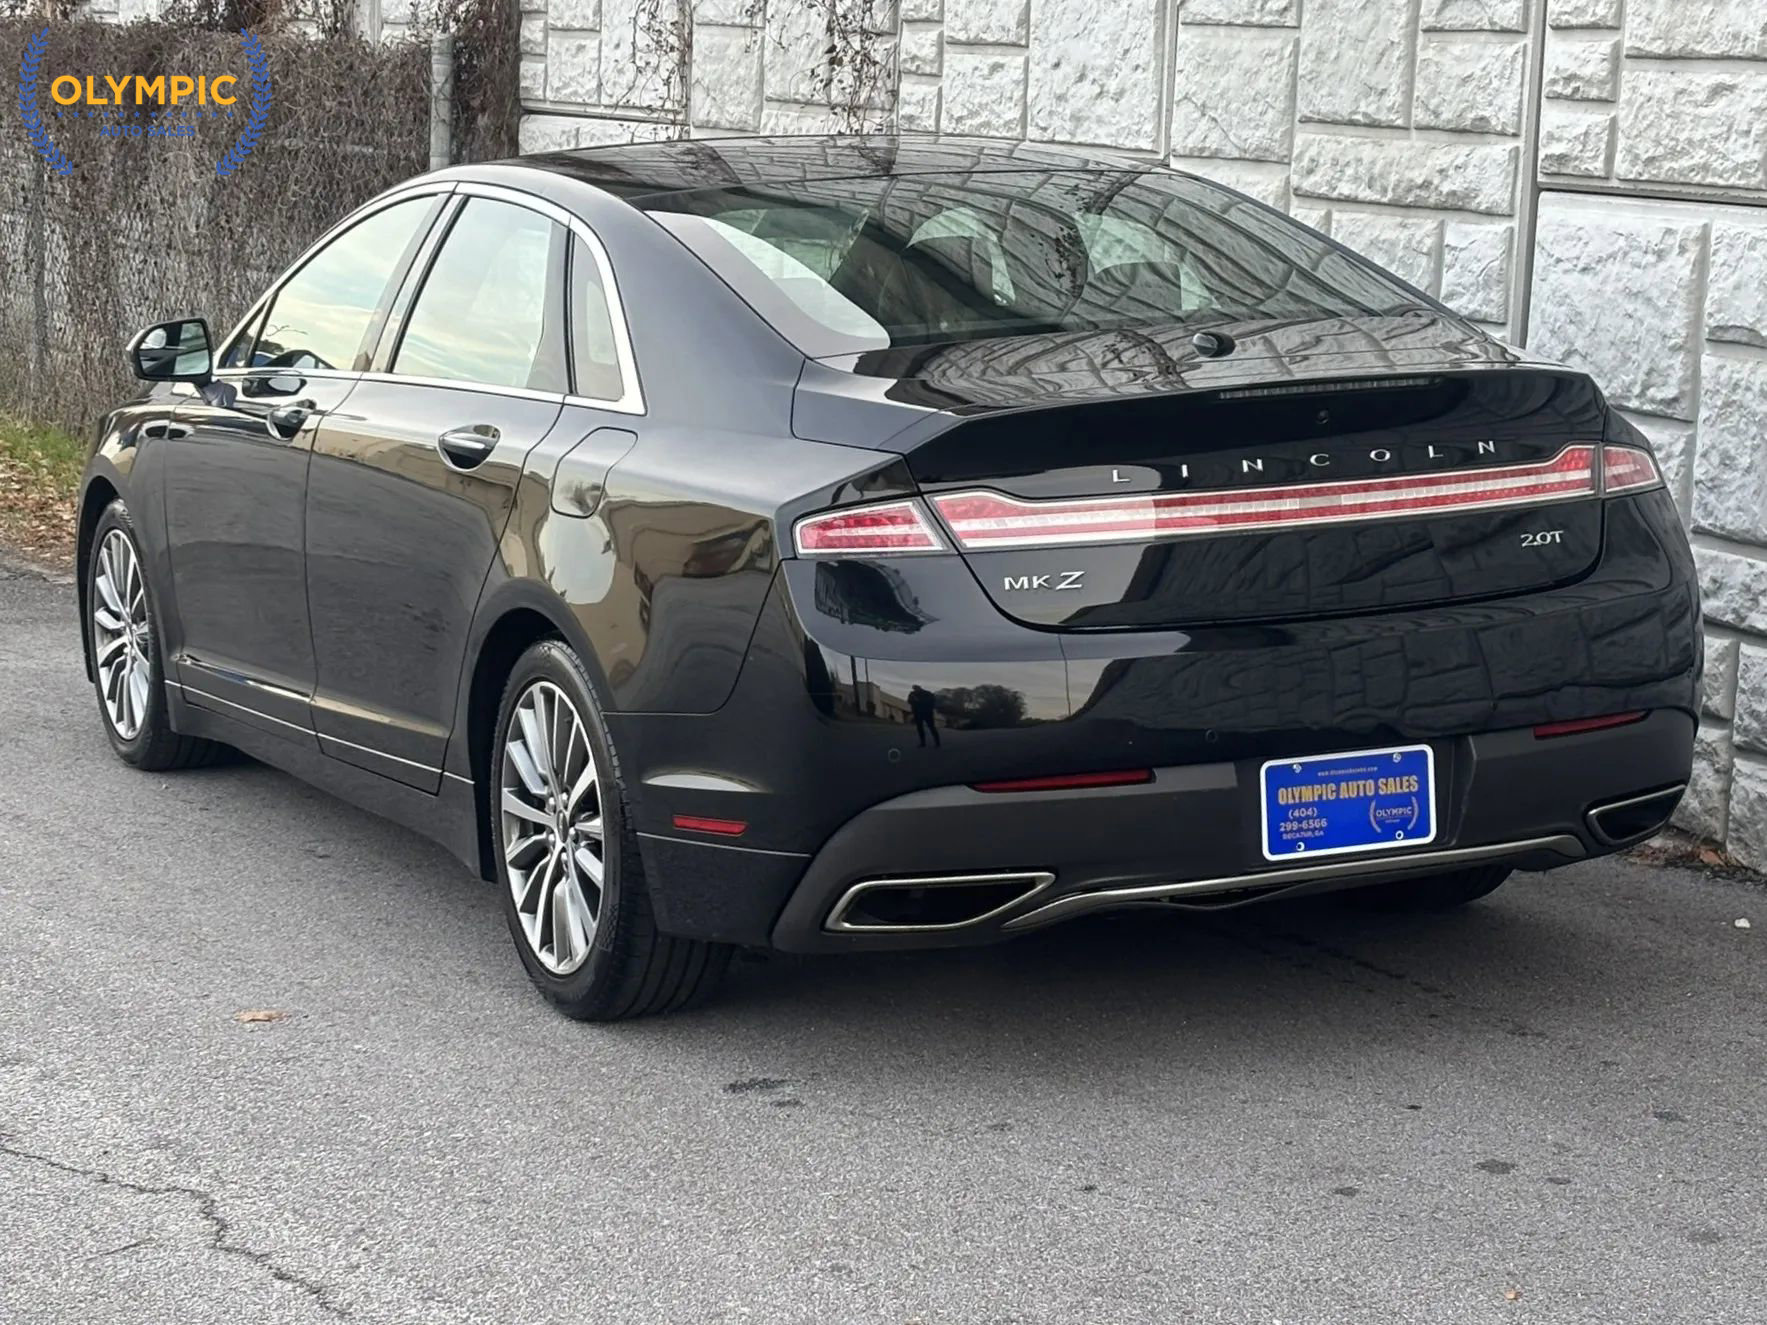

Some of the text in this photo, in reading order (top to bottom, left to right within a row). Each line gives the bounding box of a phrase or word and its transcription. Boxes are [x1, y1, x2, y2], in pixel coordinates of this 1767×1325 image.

[1112, 440, 1495, 483] LINCOLN
[1278, 775, 1419, 805] OLYMPIC AUTO SALES
[1288, 807, 1318, 819] (404)
[1376, 806, 1412, 817] OLYMPIC
